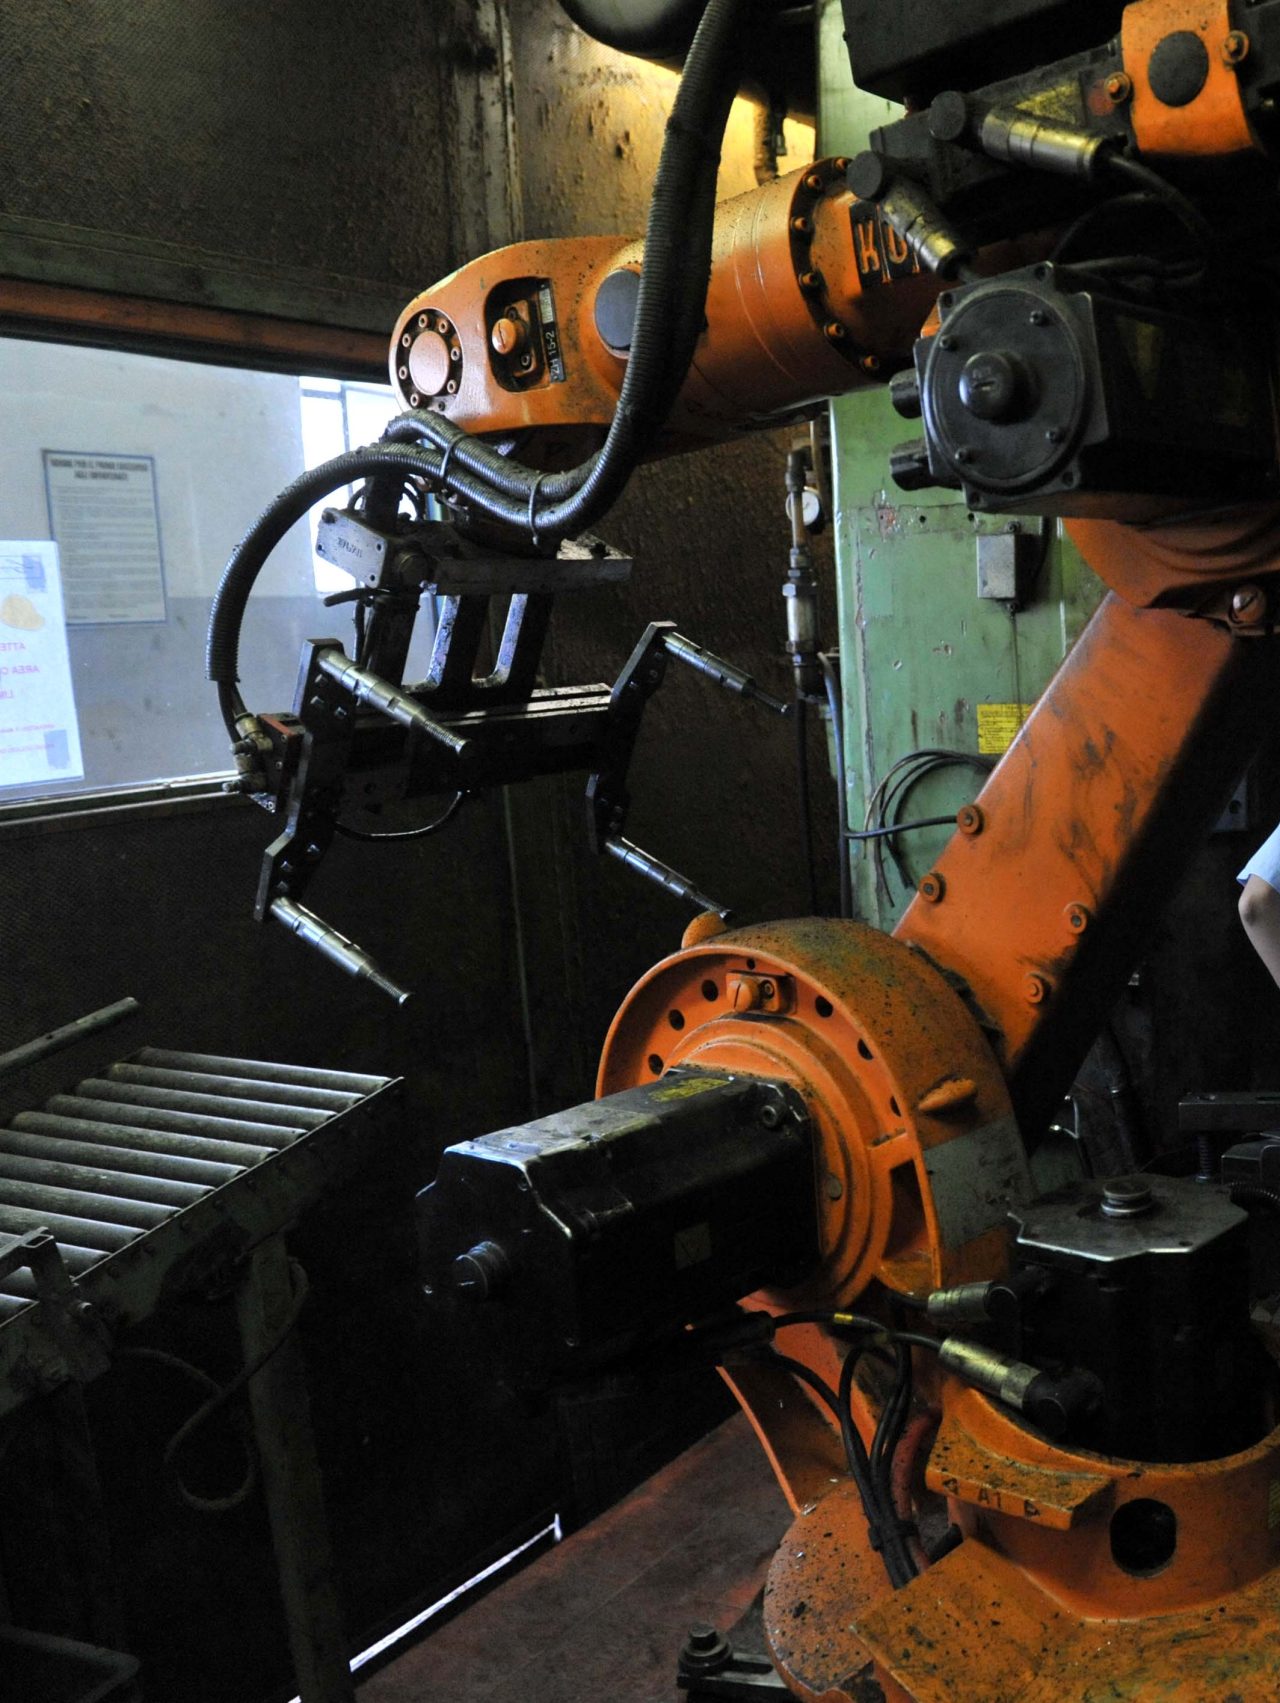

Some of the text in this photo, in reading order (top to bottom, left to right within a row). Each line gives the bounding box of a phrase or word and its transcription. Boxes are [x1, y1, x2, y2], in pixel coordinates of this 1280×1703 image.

[857, 219, 909, 275] KU
[545, 330, 557, 356] 15-2
[978, 1487, 1001, 1508] A1
